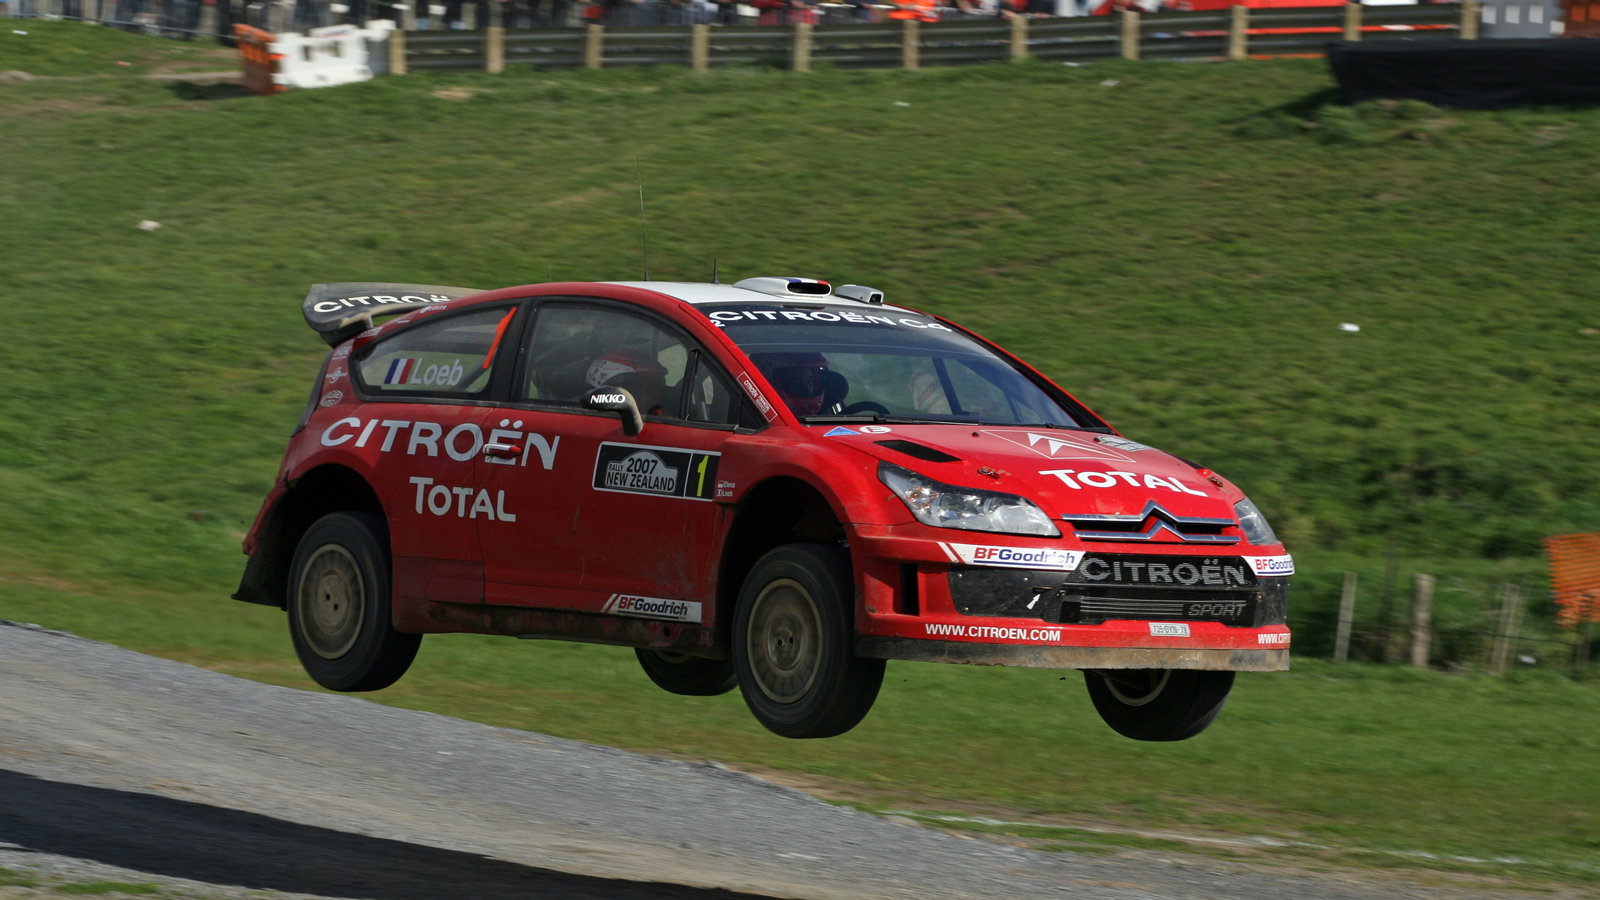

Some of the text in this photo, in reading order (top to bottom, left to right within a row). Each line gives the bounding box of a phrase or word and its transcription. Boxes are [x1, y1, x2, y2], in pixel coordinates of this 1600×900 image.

[708, 310, 953, 332] CITROËN C4
[410, 357, 464, 386] Loeb
[590, 394, 626, 404] NIKKO
[320, 416, 560, 471] CITROËN
[608, 457, 658, 475] RALLY 2007
[696, 455, 709, 497] 1
[606, 472, 675, 491] NEW ZEALAND
[1037, 469, 1209, 497] TOTAL
[409, 476, 516, 522] TOTAL
[973, 547, 1075, 564] BFGoodrich
[1079, 558, 1246, 585] CITROËN
[617, 597, 688, 615] BFGoodrich
[1188, 603, 1248, 616] SPORT
[925, 623, 1061, 641] WWW.CITROEN.COM
